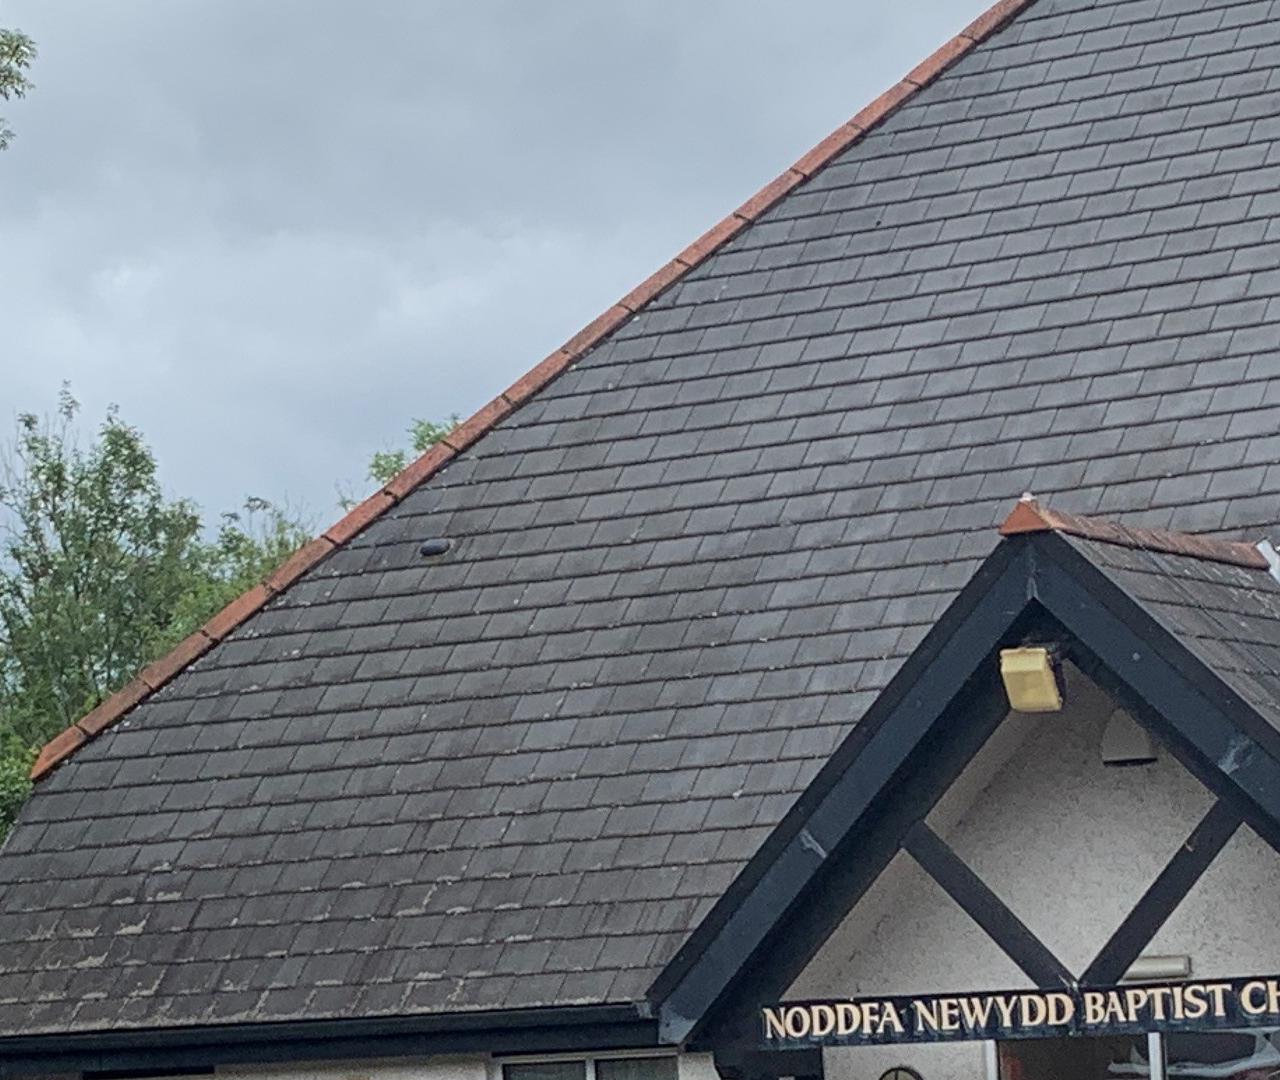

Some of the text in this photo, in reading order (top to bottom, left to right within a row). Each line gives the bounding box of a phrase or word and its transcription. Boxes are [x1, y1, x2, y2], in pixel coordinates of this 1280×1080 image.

[763, 1002, 905, 1040] NODDFA
[913, 992, 1075, 1033] NEWYDD
[1083, 983, 1233, 1025] BAPTIST
